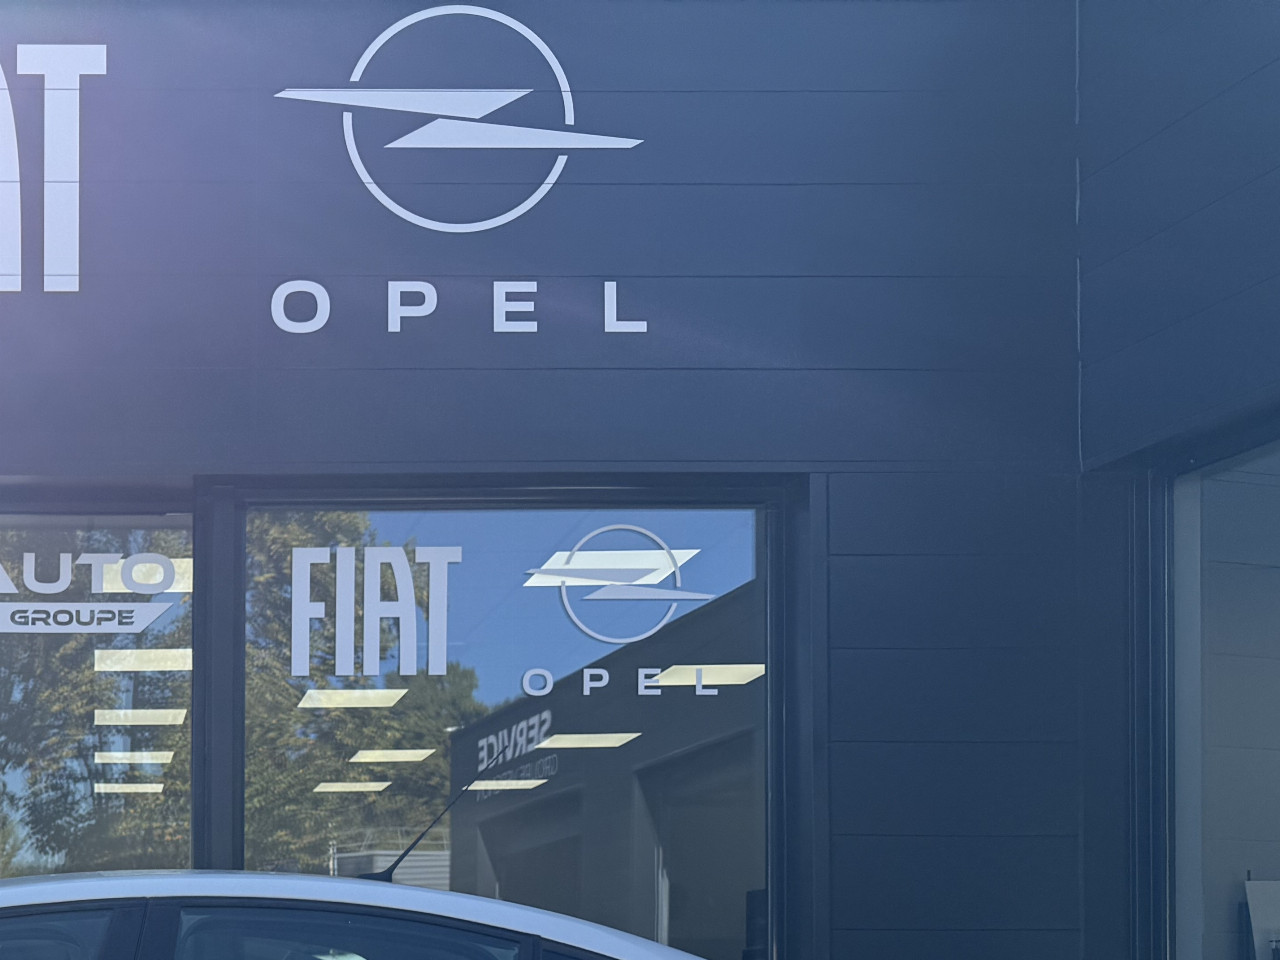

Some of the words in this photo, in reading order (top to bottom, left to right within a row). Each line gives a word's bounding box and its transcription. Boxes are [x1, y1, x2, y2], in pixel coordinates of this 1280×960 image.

[270, 279, 648, 334] OPEL
[9, 609, 135, 627] GROUPE
[290, 546, 462, 677] FIAT
[521, 668, 719, 697] OPEL
